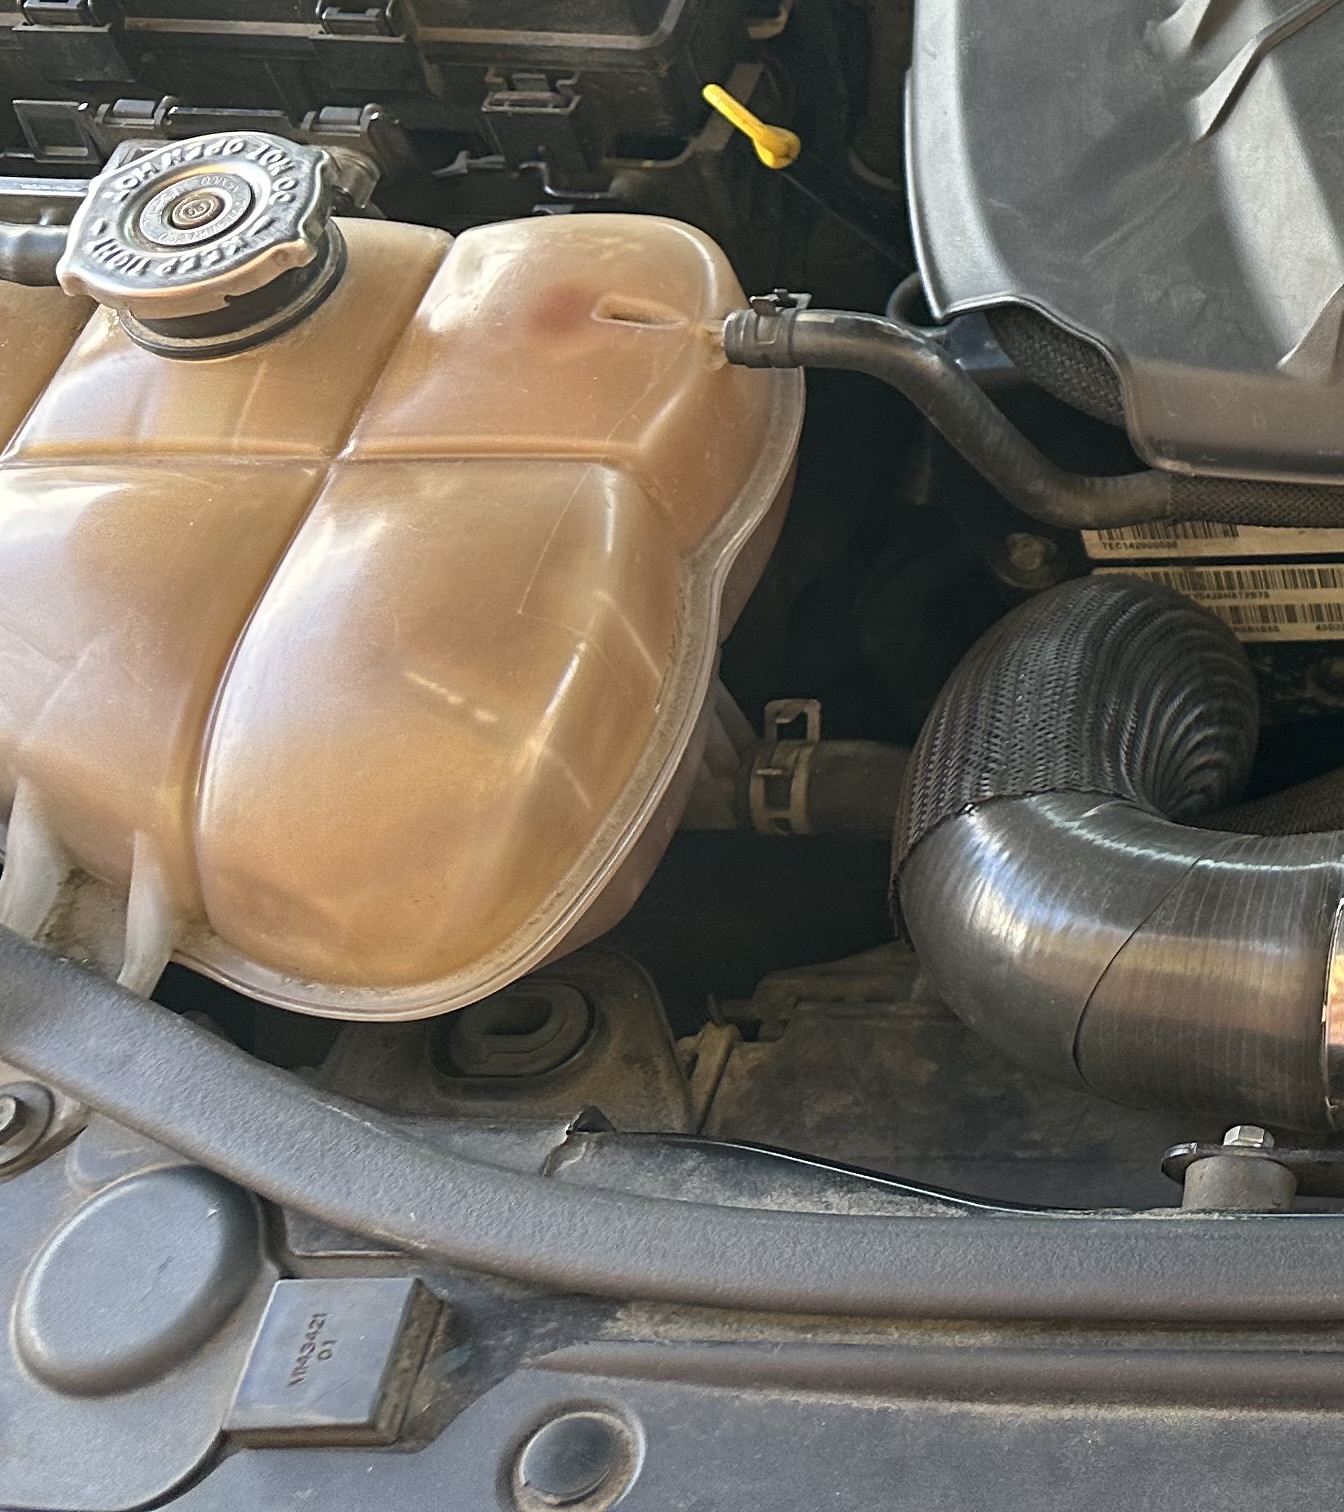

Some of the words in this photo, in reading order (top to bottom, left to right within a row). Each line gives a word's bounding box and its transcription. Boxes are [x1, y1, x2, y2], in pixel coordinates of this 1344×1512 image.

[160, 138, 247, 169] OPEN
[246, 142, 295, 179] NOT
[101, 158, 160, 203] HOT
[269, 176, 300, 205] DO
[155, 235, 250, 277] KEEP
